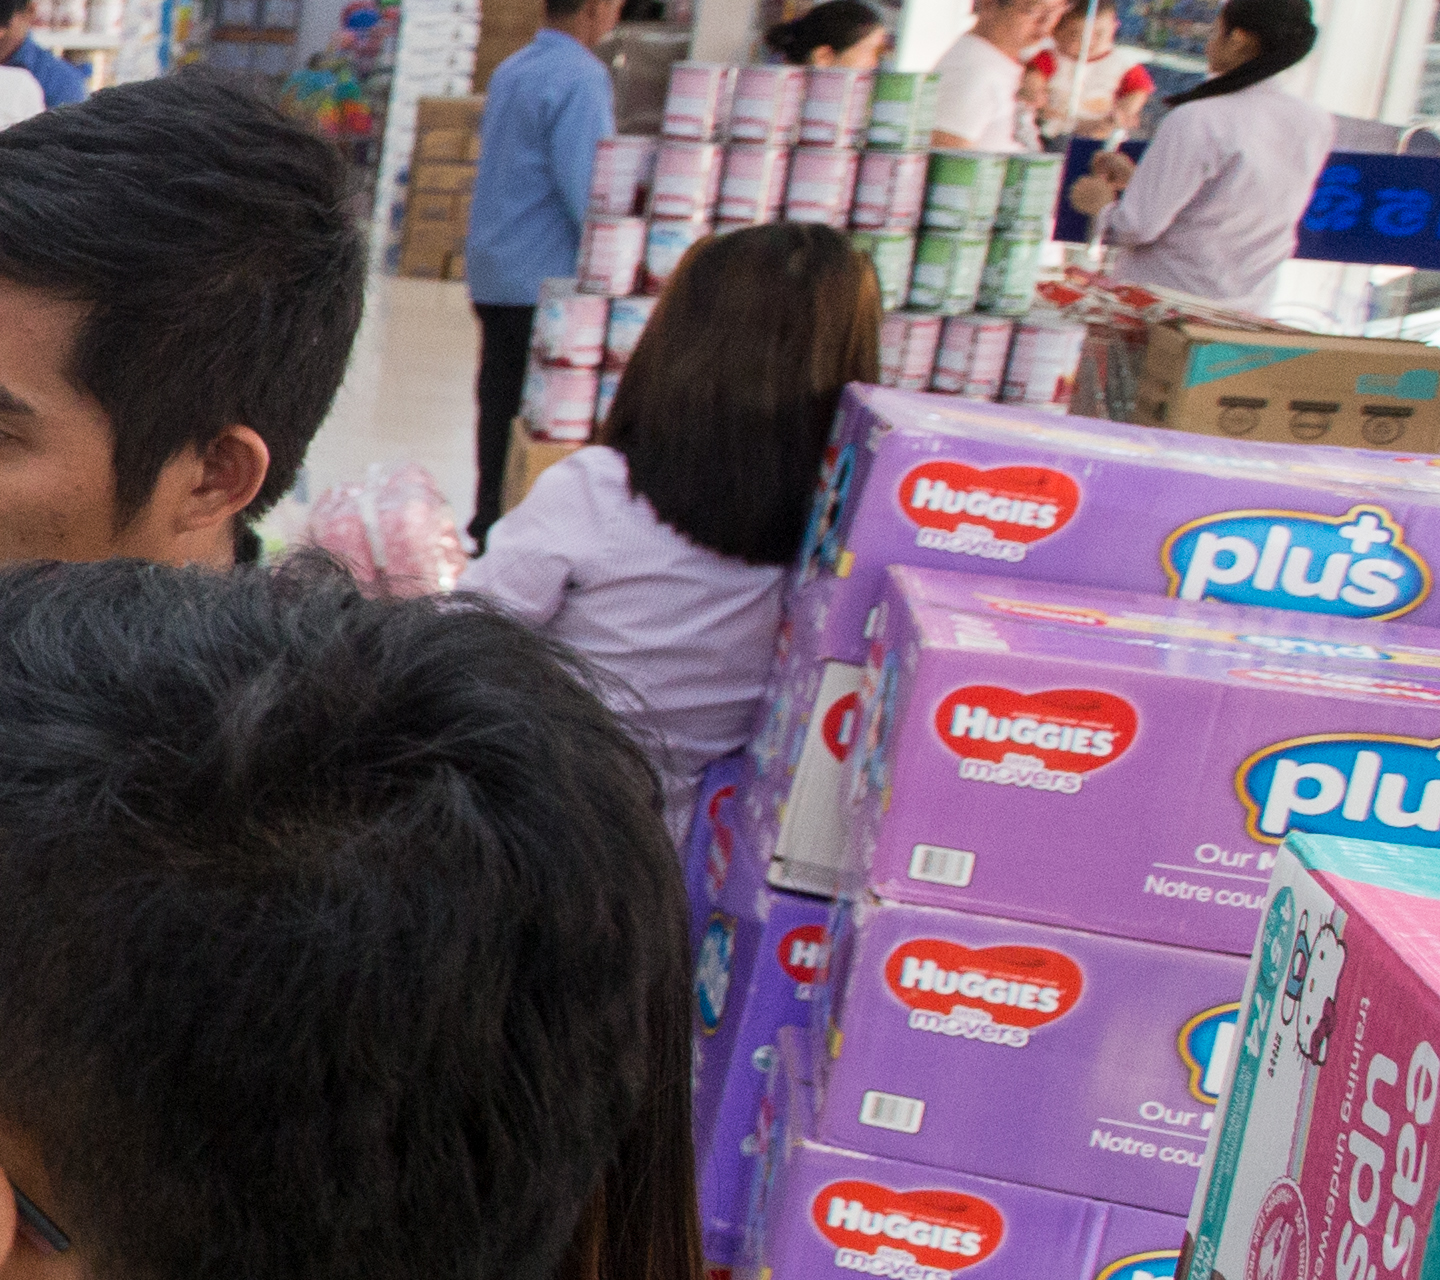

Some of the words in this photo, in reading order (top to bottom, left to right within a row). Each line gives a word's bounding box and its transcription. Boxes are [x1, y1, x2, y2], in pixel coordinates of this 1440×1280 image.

[910, 475, 1061, 529] HUGGIES
[916, 528, 1031, 562] movers
[1178, 517, 1408, 608] plus
[950, 702, 1122, 759] HUGGIES
[959, 758, 1088, 795] movers
[1194, 843, 1252, 869] Our
[1143, 873, 1213, 902] Notre
[900, 956, 1062, 1015] HUGGIES
[908, 1009, 1031, 1049] movers
[1339, 994, 1372, 1121] training
[1139, 1100, 1196, 1129] Our
[1089, 1126, 1157, 1156] Notre
[827, 1197, 984, 1258] HUGGIES
